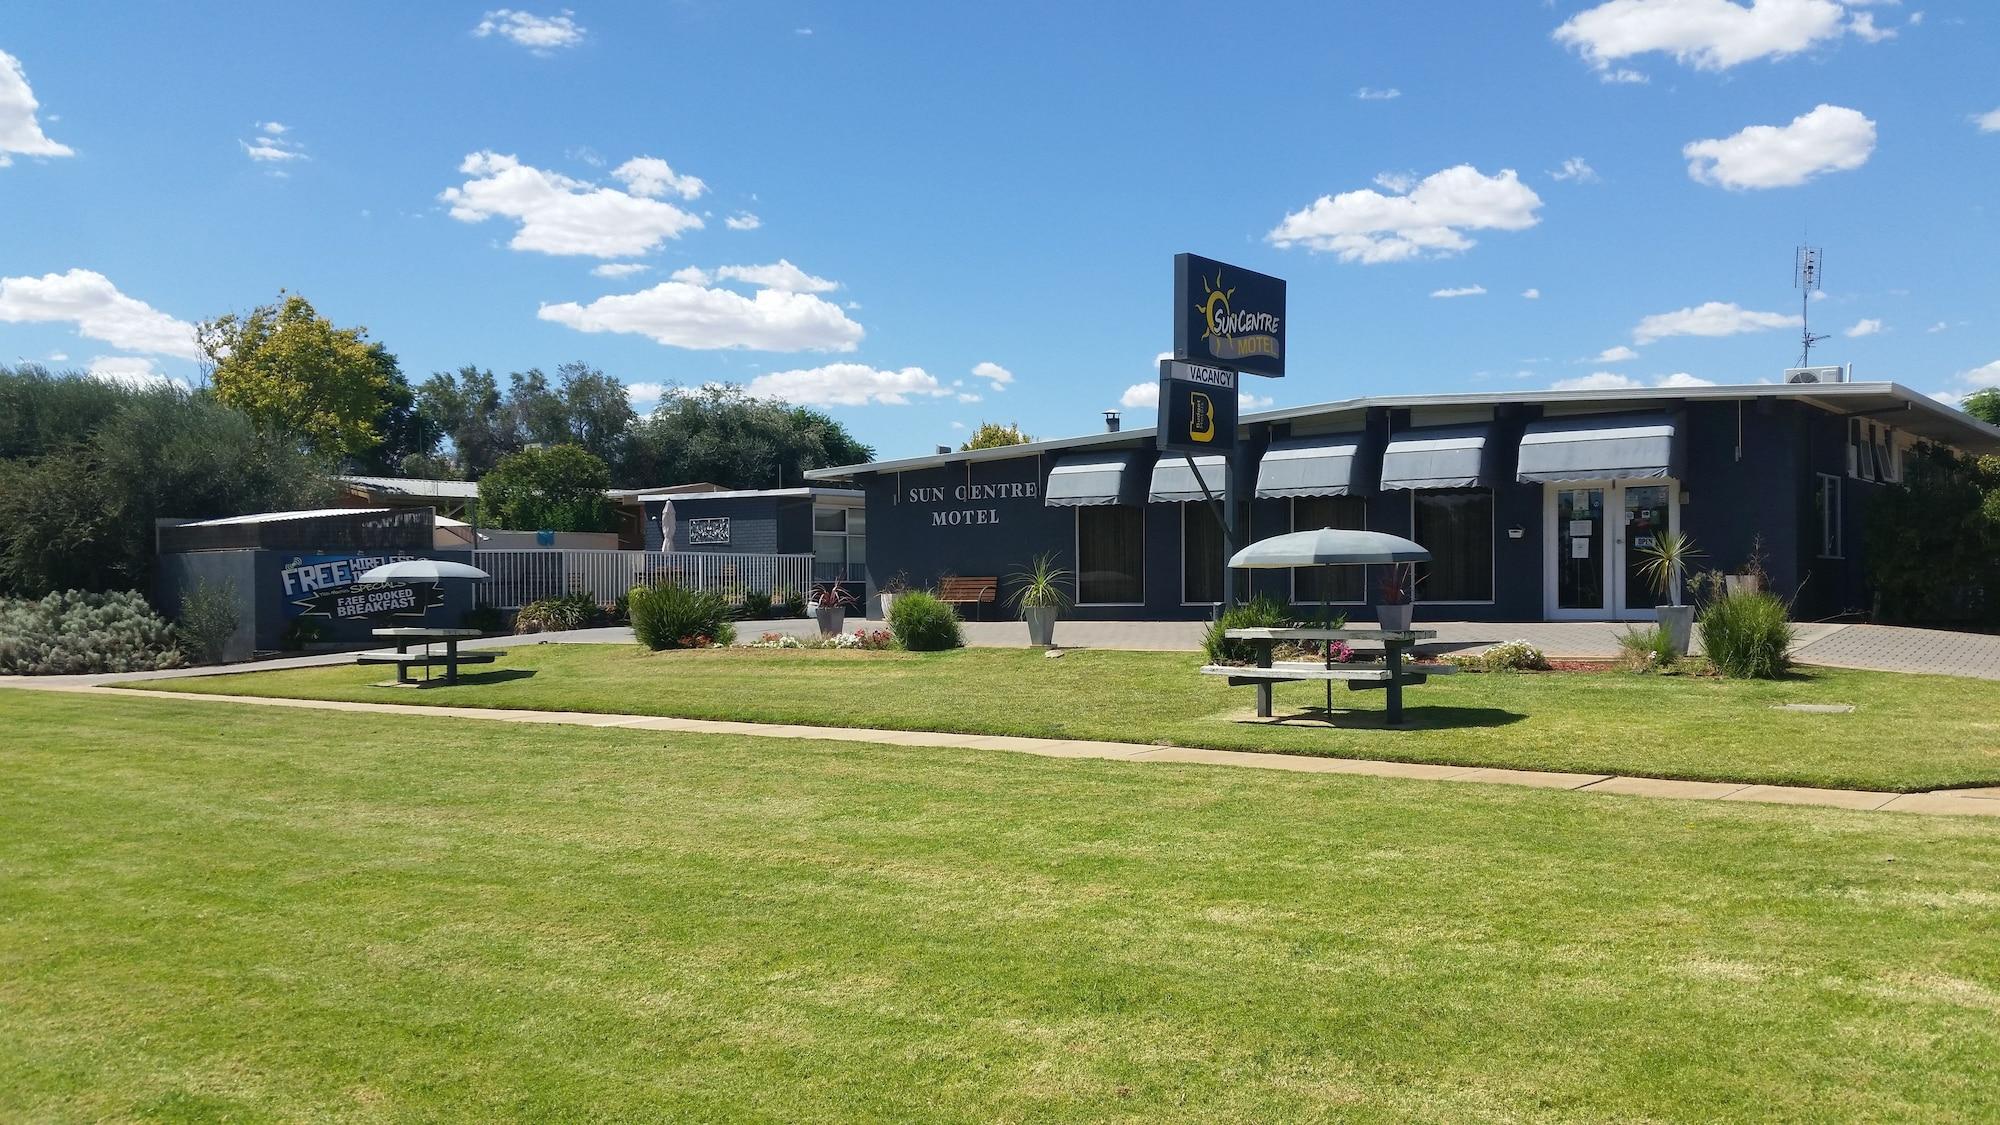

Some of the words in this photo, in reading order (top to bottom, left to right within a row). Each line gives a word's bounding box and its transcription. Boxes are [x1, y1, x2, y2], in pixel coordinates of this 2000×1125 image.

[1238, 335, 1278, 356] MOTEL
[1190, 366, 1232, 387] VACANCY
[909, 487, 945, 503] SUN
[954, 482, 1037, 501] CENTRE
[931, 509, 1000, 526] MOTEL
[281, 560, 352, 596] FREE
[349, 581, 407, 594] SPECIALS
[337, 595, 366, 606] FREE
[368, 588, 413, 603] COOKED
[337, 596, 416, 617] BREAKFAST
